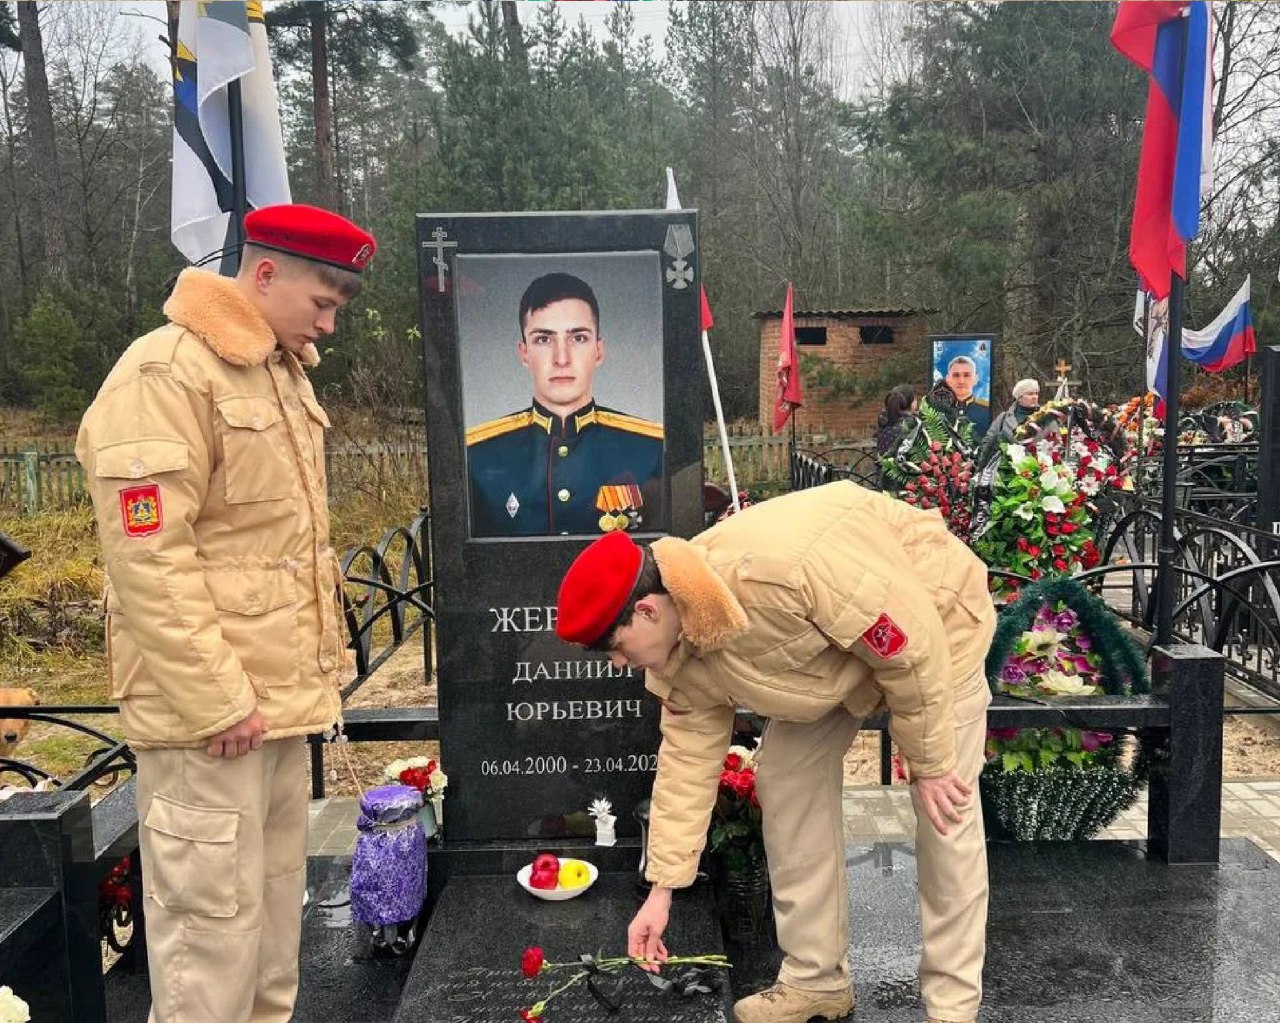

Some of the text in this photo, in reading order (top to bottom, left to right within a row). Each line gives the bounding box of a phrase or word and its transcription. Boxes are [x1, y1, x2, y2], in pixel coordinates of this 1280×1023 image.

[507, 699, 643, 721] ЮРЬЕВИЧ
[481, 755, 568, 776] 06.04.2000
[584, 754, 659, 773] 23.04.202
